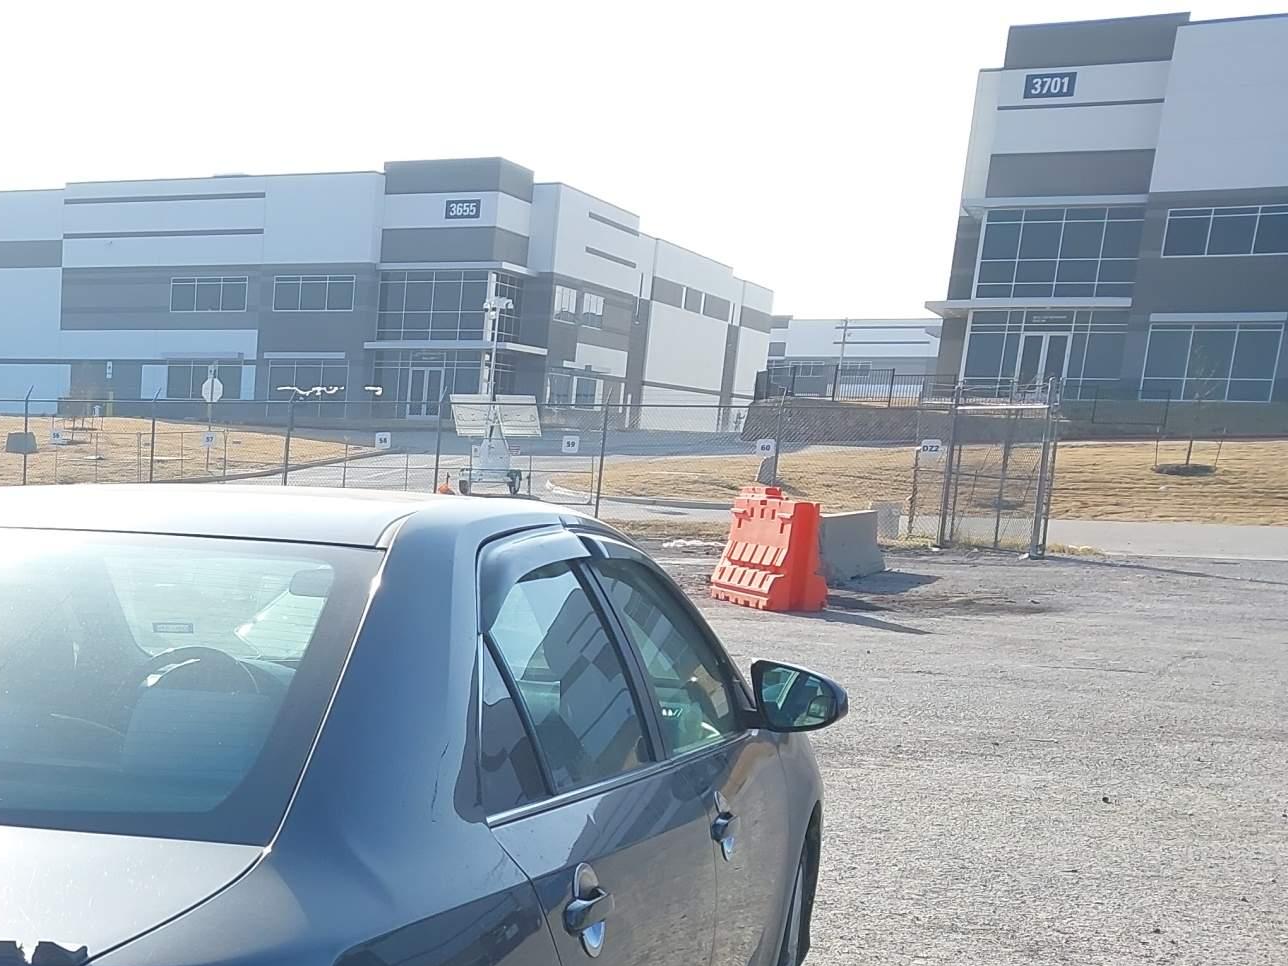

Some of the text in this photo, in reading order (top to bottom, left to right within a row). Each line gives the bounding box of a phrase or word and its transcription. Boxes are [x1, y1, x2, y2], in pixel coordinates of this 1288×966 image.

[1031, 76, 1069, 95] 3701
[449, 202, 477, 216] 3655
[566, 440, 576, 448] 59
